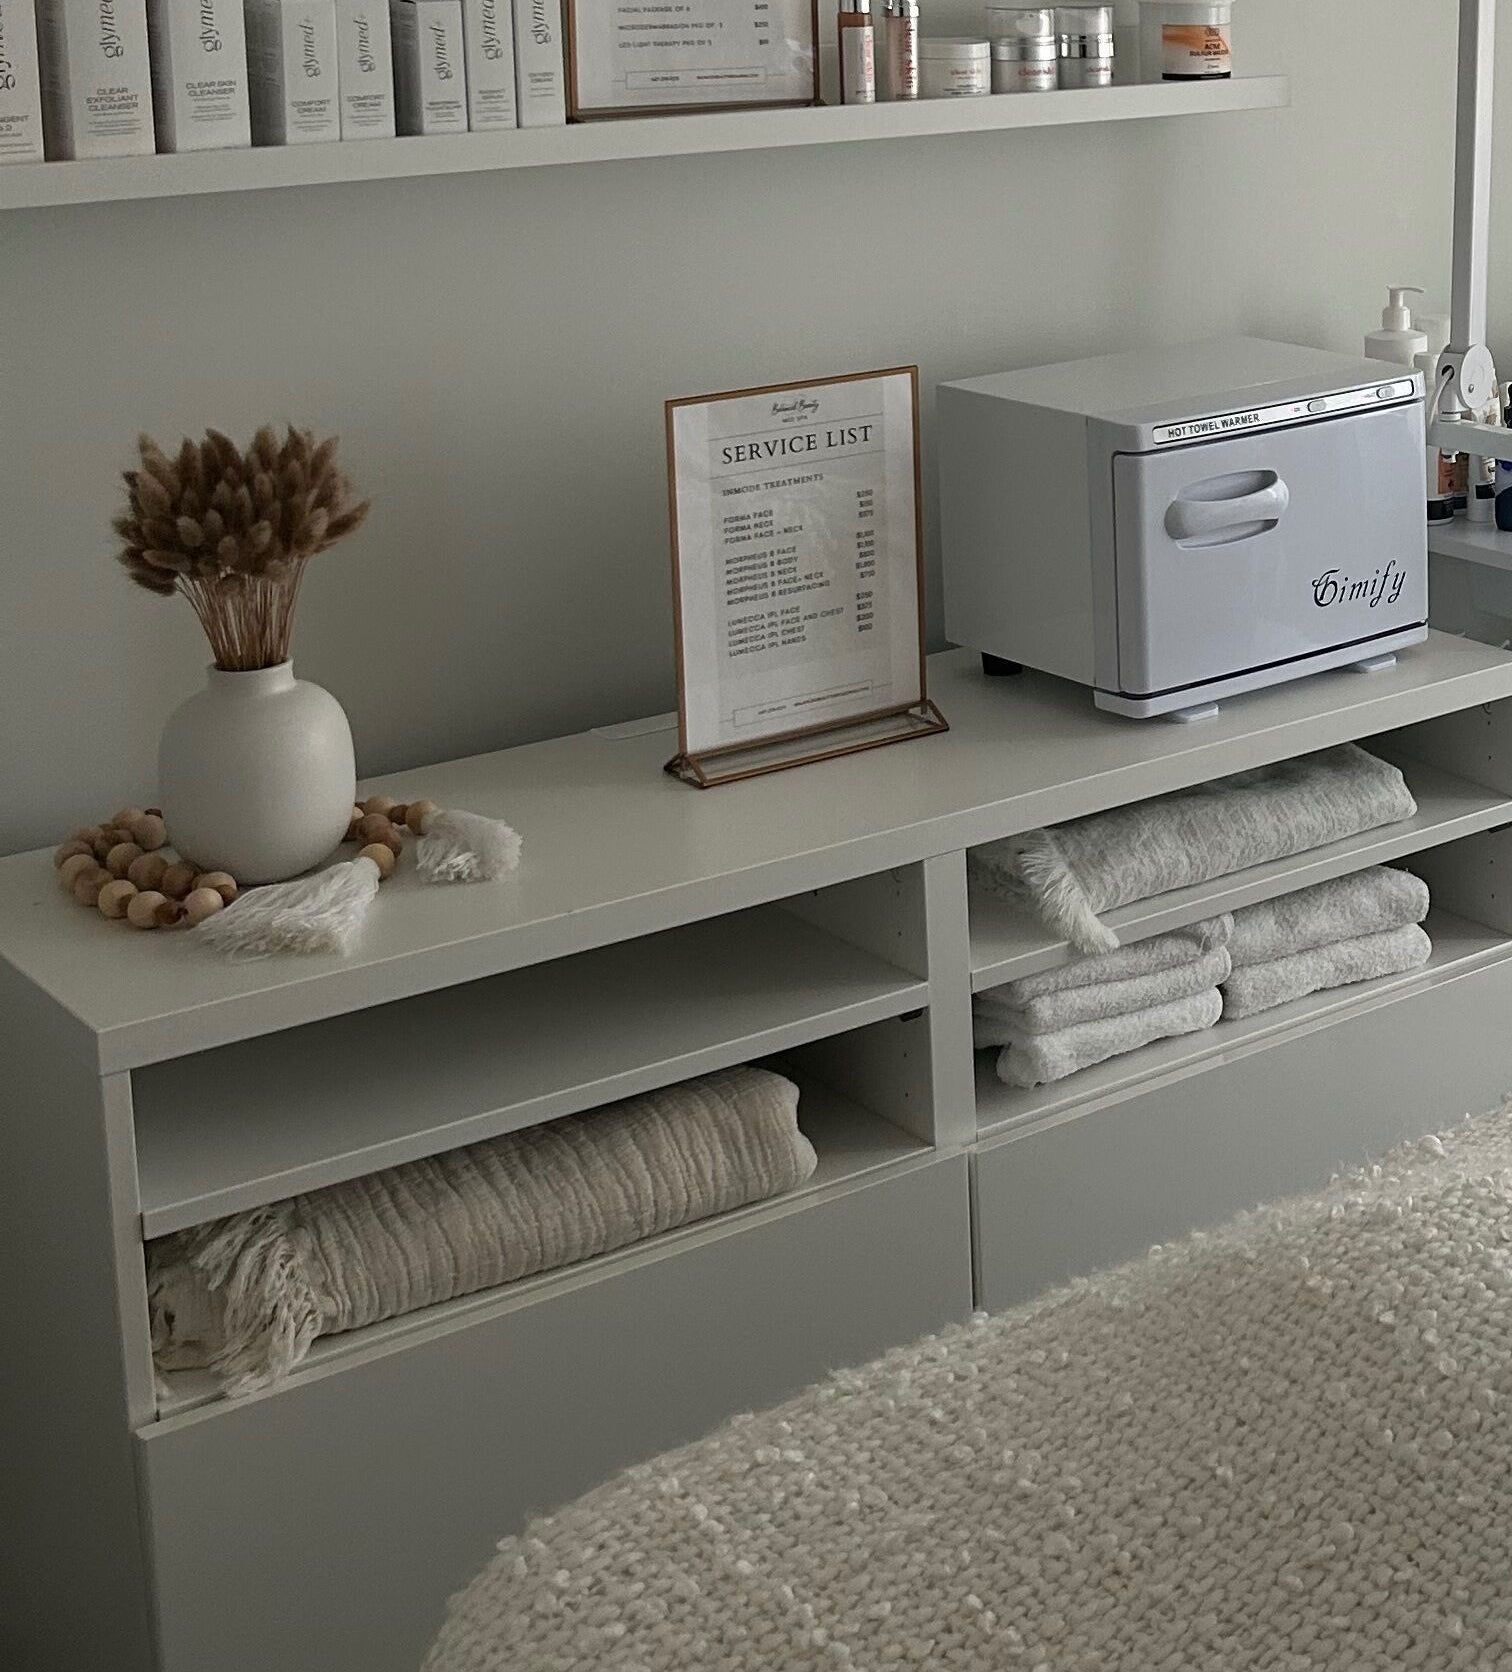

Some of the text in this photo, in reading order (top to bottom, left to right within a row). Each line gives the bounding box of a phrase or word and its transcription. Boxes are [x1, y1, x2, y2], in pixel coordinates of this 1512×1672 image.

[100, 0, 124, 59] glyme
[186, 81, 216, 90] CLEAR
[1168, 413, 1260, 438] HOT TOWEL WARMER
[722, 424, 873, 465] SERVICE LIST
[764, 473, 824, 490] TREATMENTS
[1311, 559, 1407, 608] Gimify
